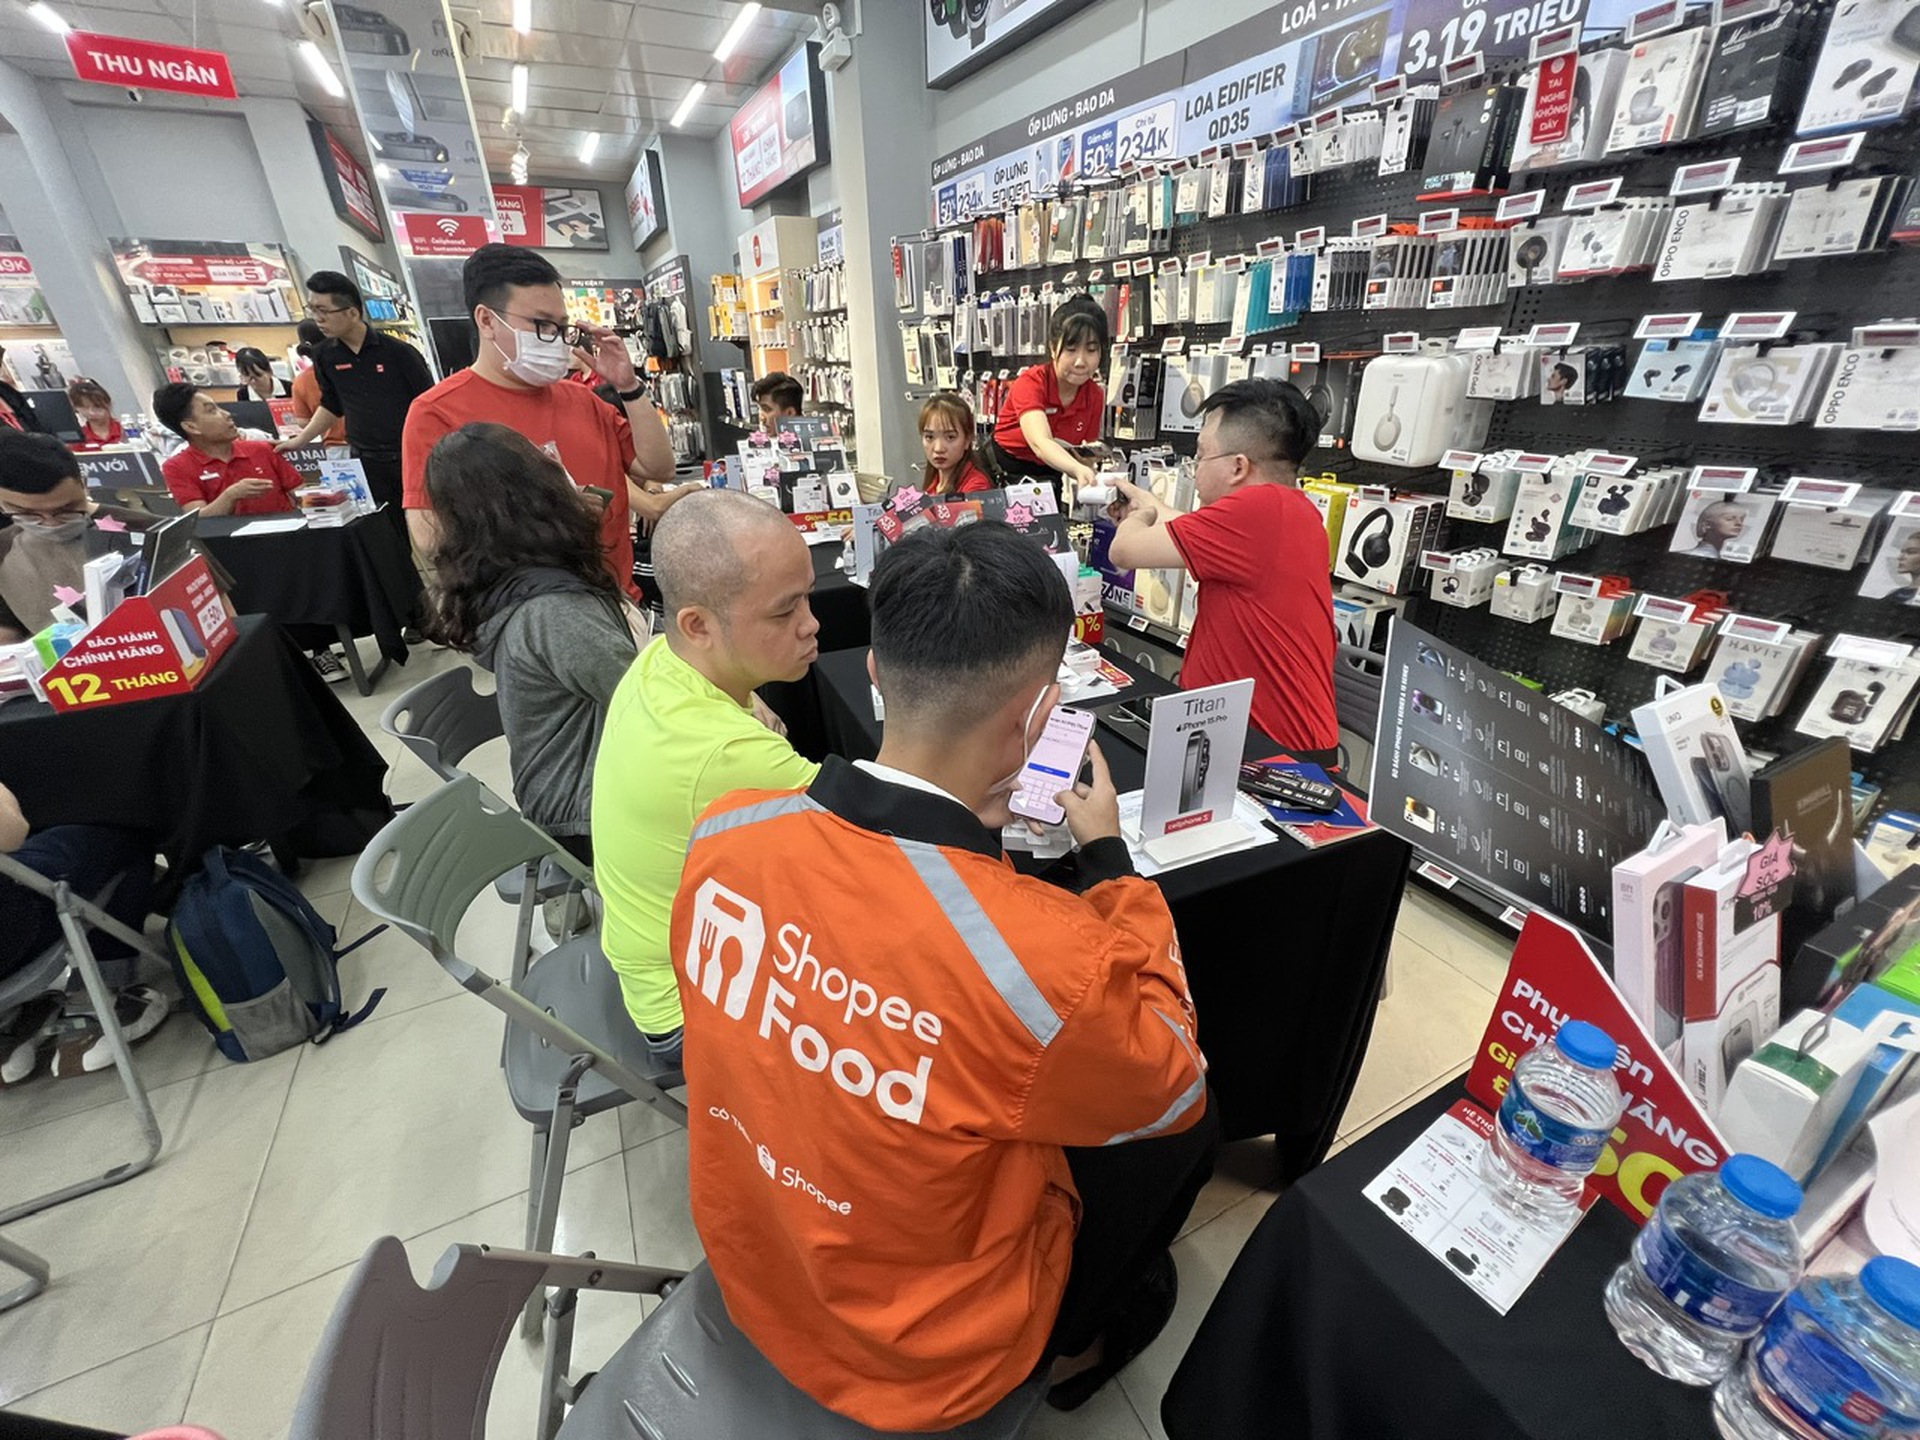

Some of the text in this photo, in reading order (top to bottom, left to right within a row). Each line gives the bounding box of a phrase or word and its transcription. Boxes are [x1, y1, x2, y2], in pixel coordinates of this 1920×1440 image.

[1281, 0, 1317, 34] LOA
[1405, 10, 1487, 75] 3.19
[88, 51, 219, 87] THU NGÂN
[1548, 78, 1563, 89] TAI
[1185, 62, 1287, 122] LOA EDIFIER
[1539, 90, 1568, 104] NGHE
[1028, 118, 1041, 137] ỐP
[1041, 109, 1068, 132] LƯNG
[1075, 96, 1097, 118] BAO
[1099, 88, 1115, 109] DA
[1208, 108, 1251, 140] QD35
[1534, 104, 1569, 119] KHÔNG
[1539, 119, 1560, 131] DÂY
[1006, 160, 1029, 180] LƯNG
[1084, 141, 1115, 177] 50%
[1660, 209, 1690, 277] OPPO ENCO
[1469, 354, 1483, 395] OPPO ENCO
[1824, 353, 1861, 424] OPPO ENCO
[99, 458, 129, 473] VỚI
[63, 644, 164, 669] CHÍNH HÃNG
[86, 630, 159, 649] BẢO HÀNH
[1728, 639, 1782, 659] HAVIT
[46, 671, 179, 706] 12 THÁNG
[1184, 696, 1226, 716] Titan
[1182, 720, 1206, 731] iPhone
[772, 923, 943, 1045] Shopee
[758, 976, 934, 1125] Food
[781, 1167, 852, 1215] Shopee
